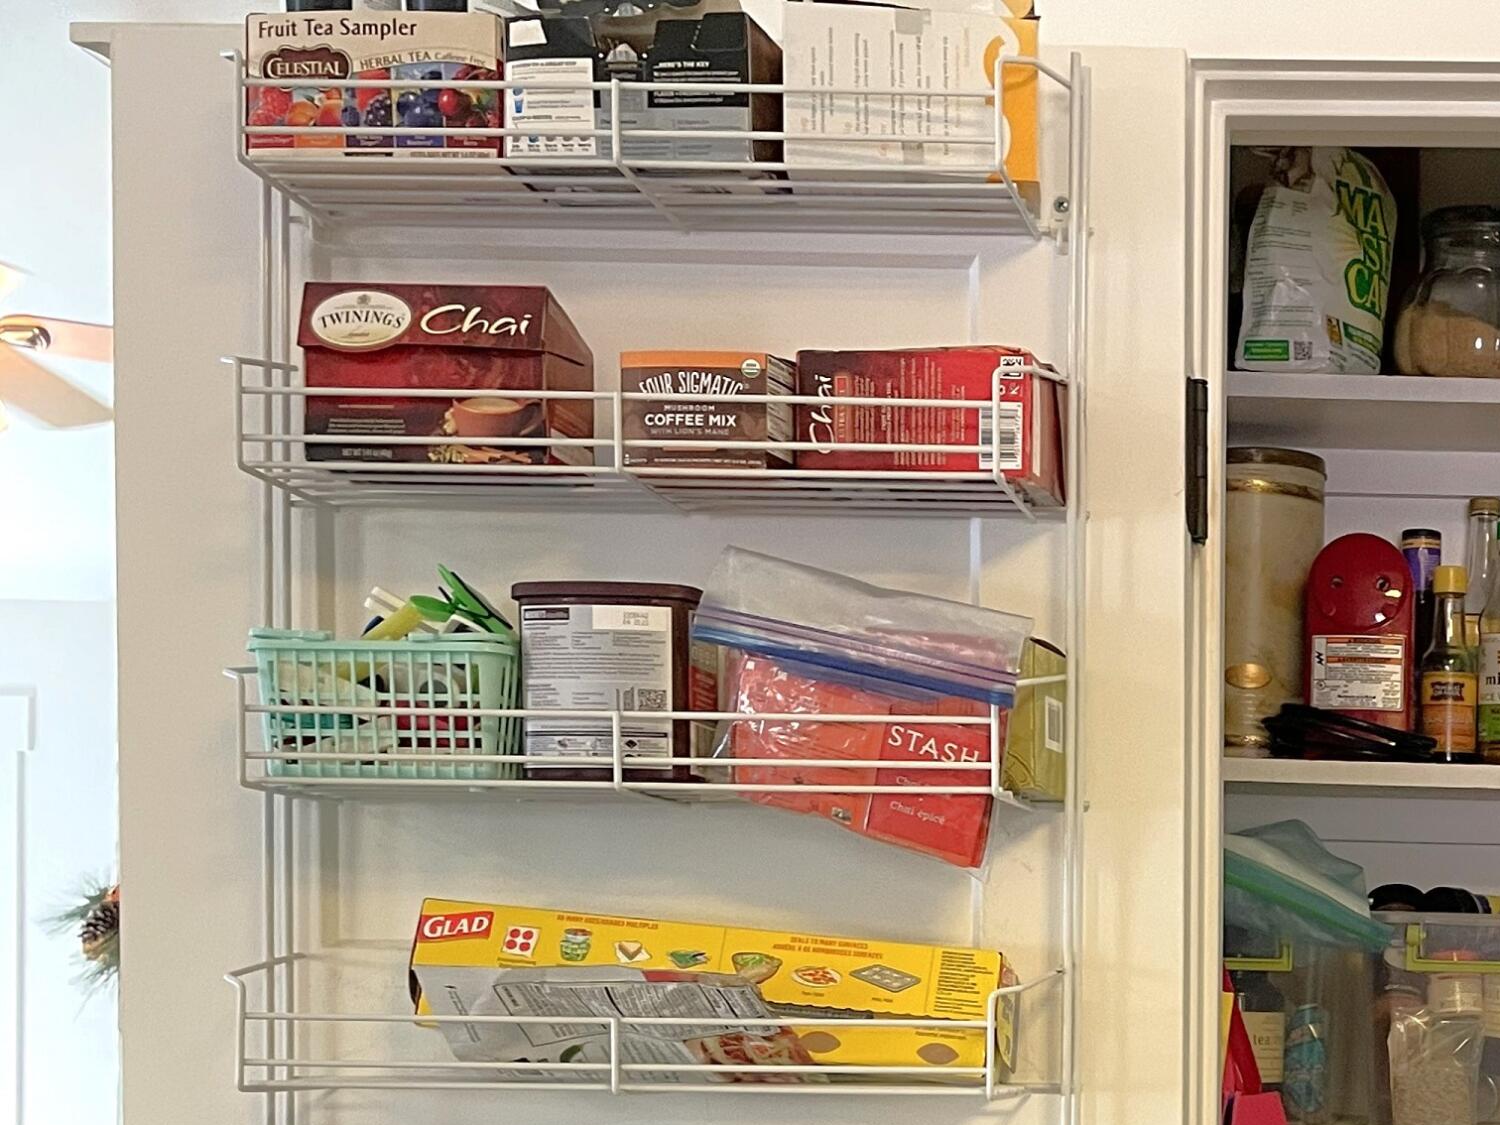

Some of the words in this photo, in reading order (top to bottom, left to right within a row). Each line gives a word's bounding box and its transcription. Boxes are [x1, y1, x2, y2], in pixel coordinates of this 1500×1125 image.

[258, 20, 298, 38] Fruit
[304, 19, 333, 36] Tea
[340, 18, 417, 40] Sampler
[266, 57, 345, 78] CELESTIAL
[360, 54, 405, 70] HERBAL
[409, 51, 432, 62] TEA
[320, 310, 405, 328] TWININGS
[420, 304, 533, 337] Chai
[678, 371, 744, 396] SIGMATIC
[663, 404, 716, 412] MUSHROOM
[808, 374, 837, 455] Chai
[644, 413, 705, 427] COFFEE
[708, 414, 737, 427] MIX
[888, 725, 979, 762] STASH
[423, 915, 490, 938] GLAD
